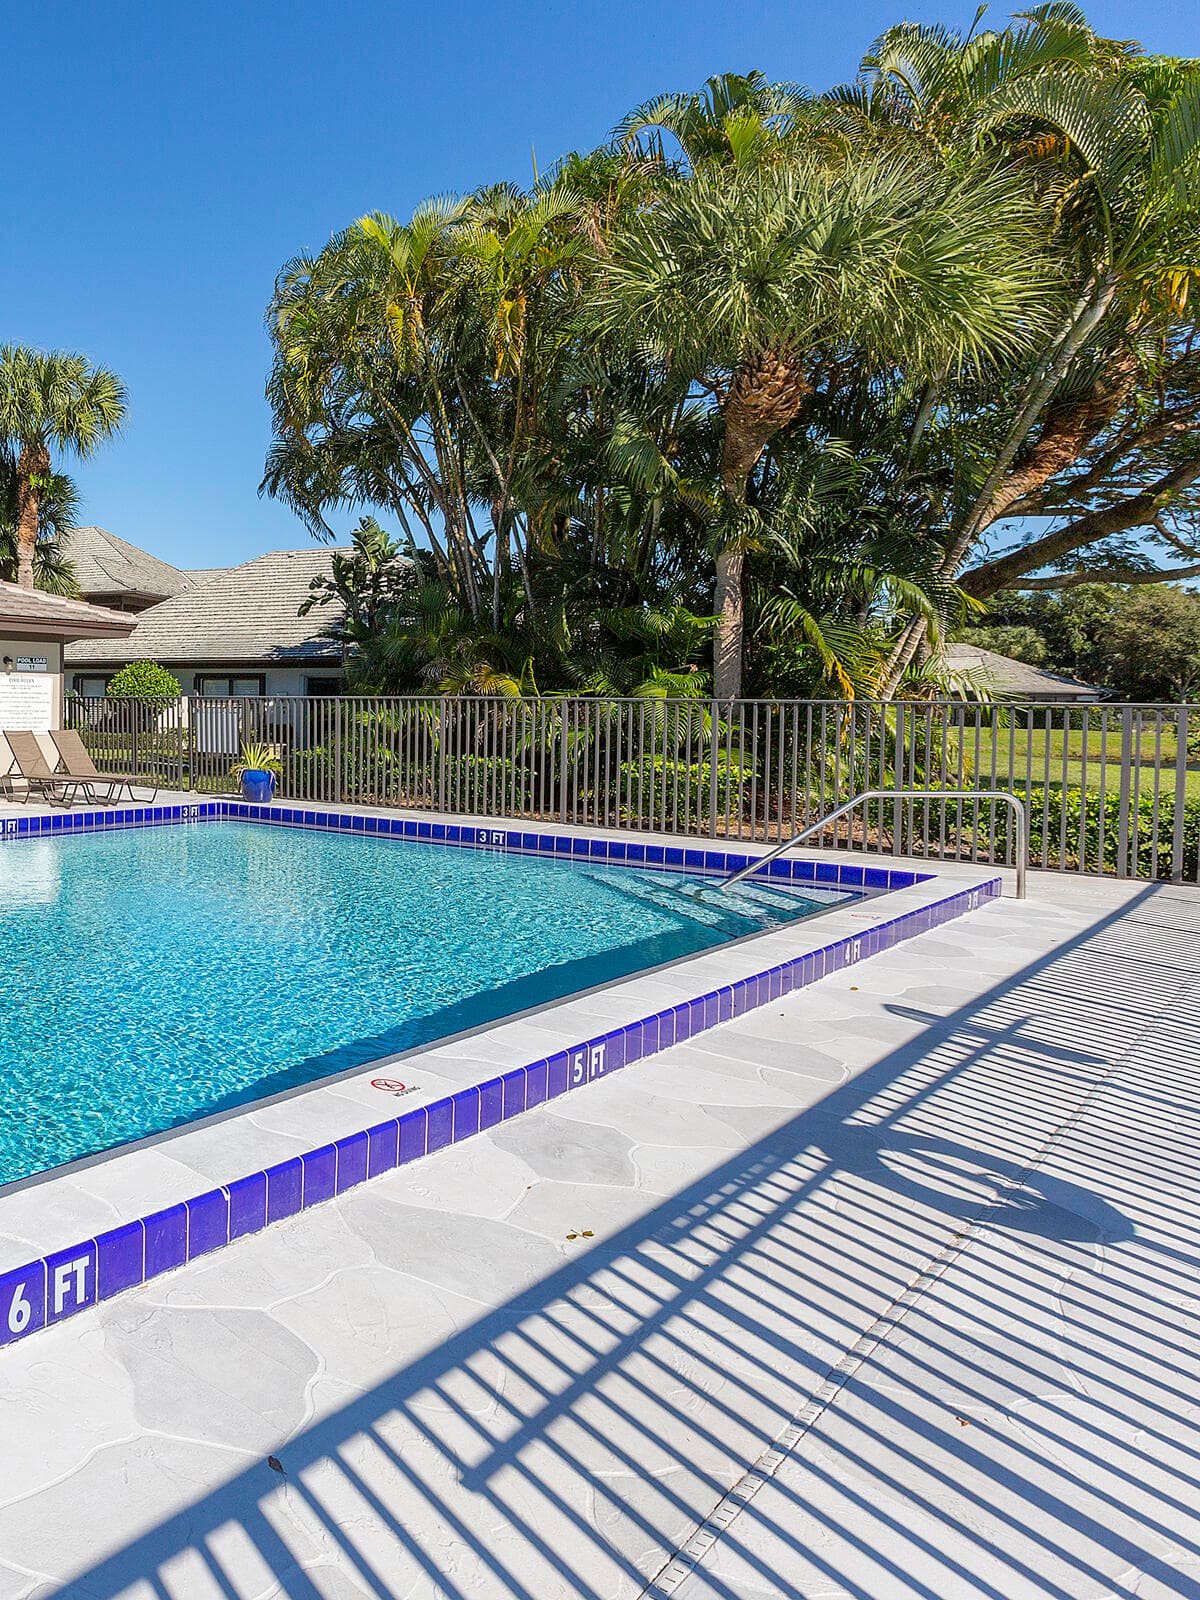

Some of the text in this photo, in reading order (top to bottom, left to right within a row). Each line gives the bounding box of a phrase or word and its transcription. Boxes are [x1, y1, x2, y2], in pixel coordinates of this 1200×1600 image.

[182, 806, 198, 817] 3 FT
[7, 820, 17, 832] FT
[479, 831, 505, 844] 3 FT
[573, 1043, 606, 1083] 5 FT
[8, 1282, 31, 1334] 6
